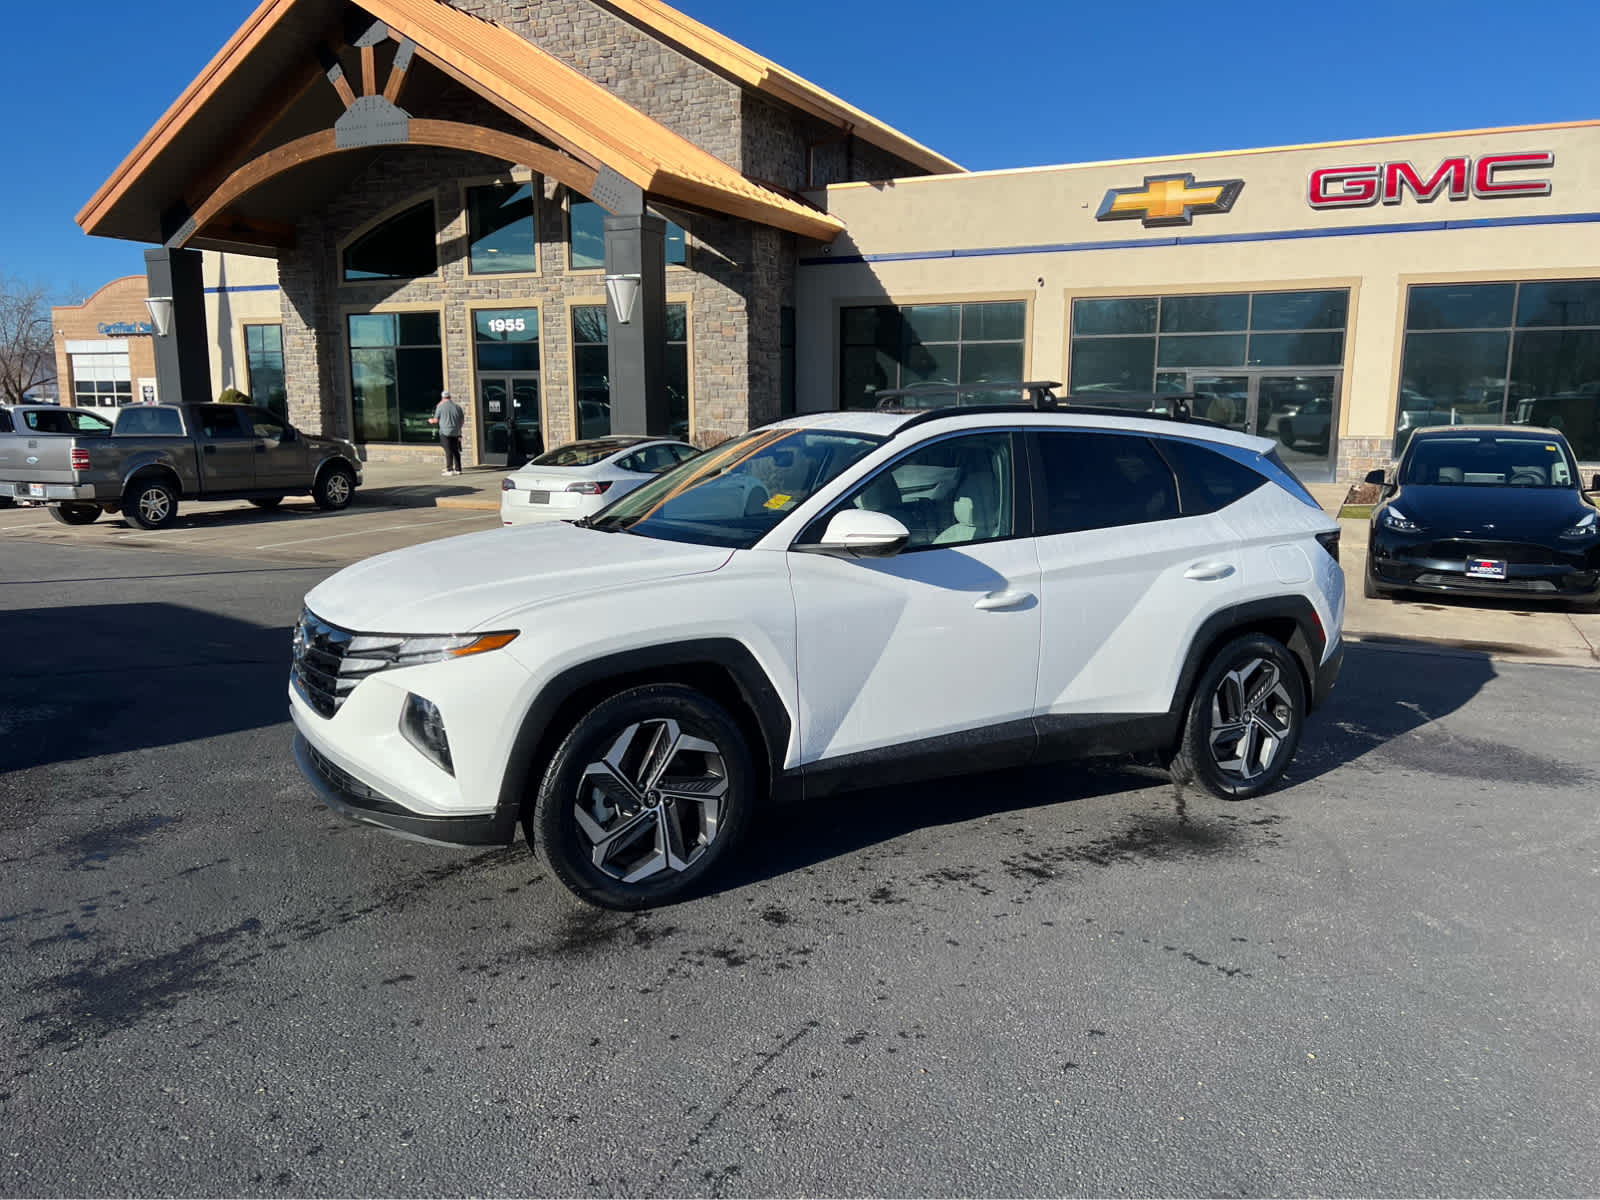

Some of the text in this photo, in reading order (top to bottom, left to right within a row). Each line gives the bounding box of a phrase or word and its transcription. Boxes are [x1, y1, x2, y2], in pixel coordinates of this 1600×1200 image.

[1307, 150, 1554, 207] GMC
[97, 321, 137, 335] Certified
[488, 318, 526, 332] 1955
